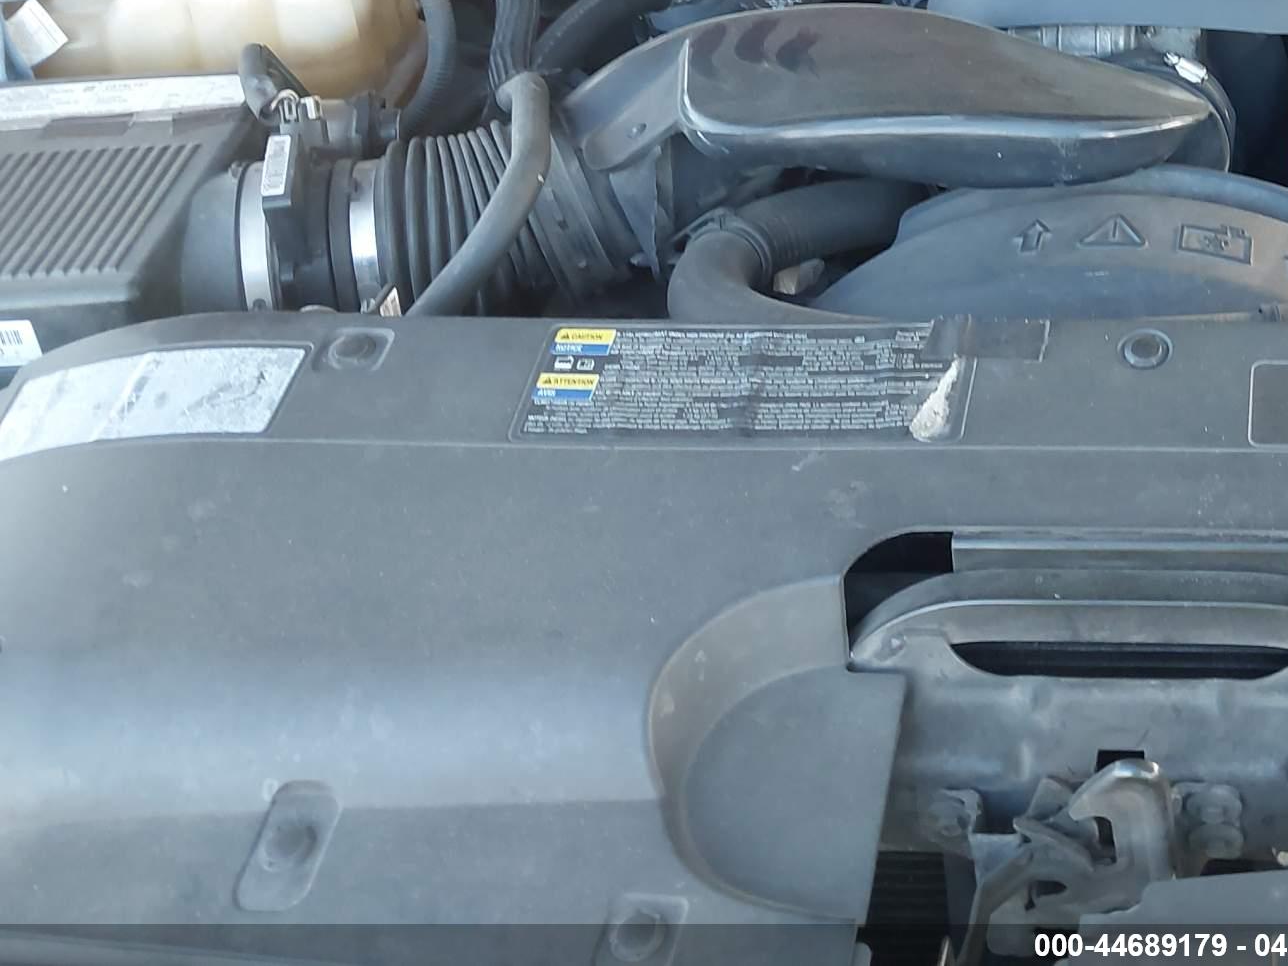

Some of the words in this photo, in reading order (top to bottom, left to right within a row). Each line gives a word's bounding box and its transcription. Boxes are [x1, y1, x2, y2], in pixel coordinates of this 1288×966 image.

[571, 333, 603, 341] CAUTION
[554, 343, 582, 353] NOTICE
[554, 377, 594, 386] ATTENTION
